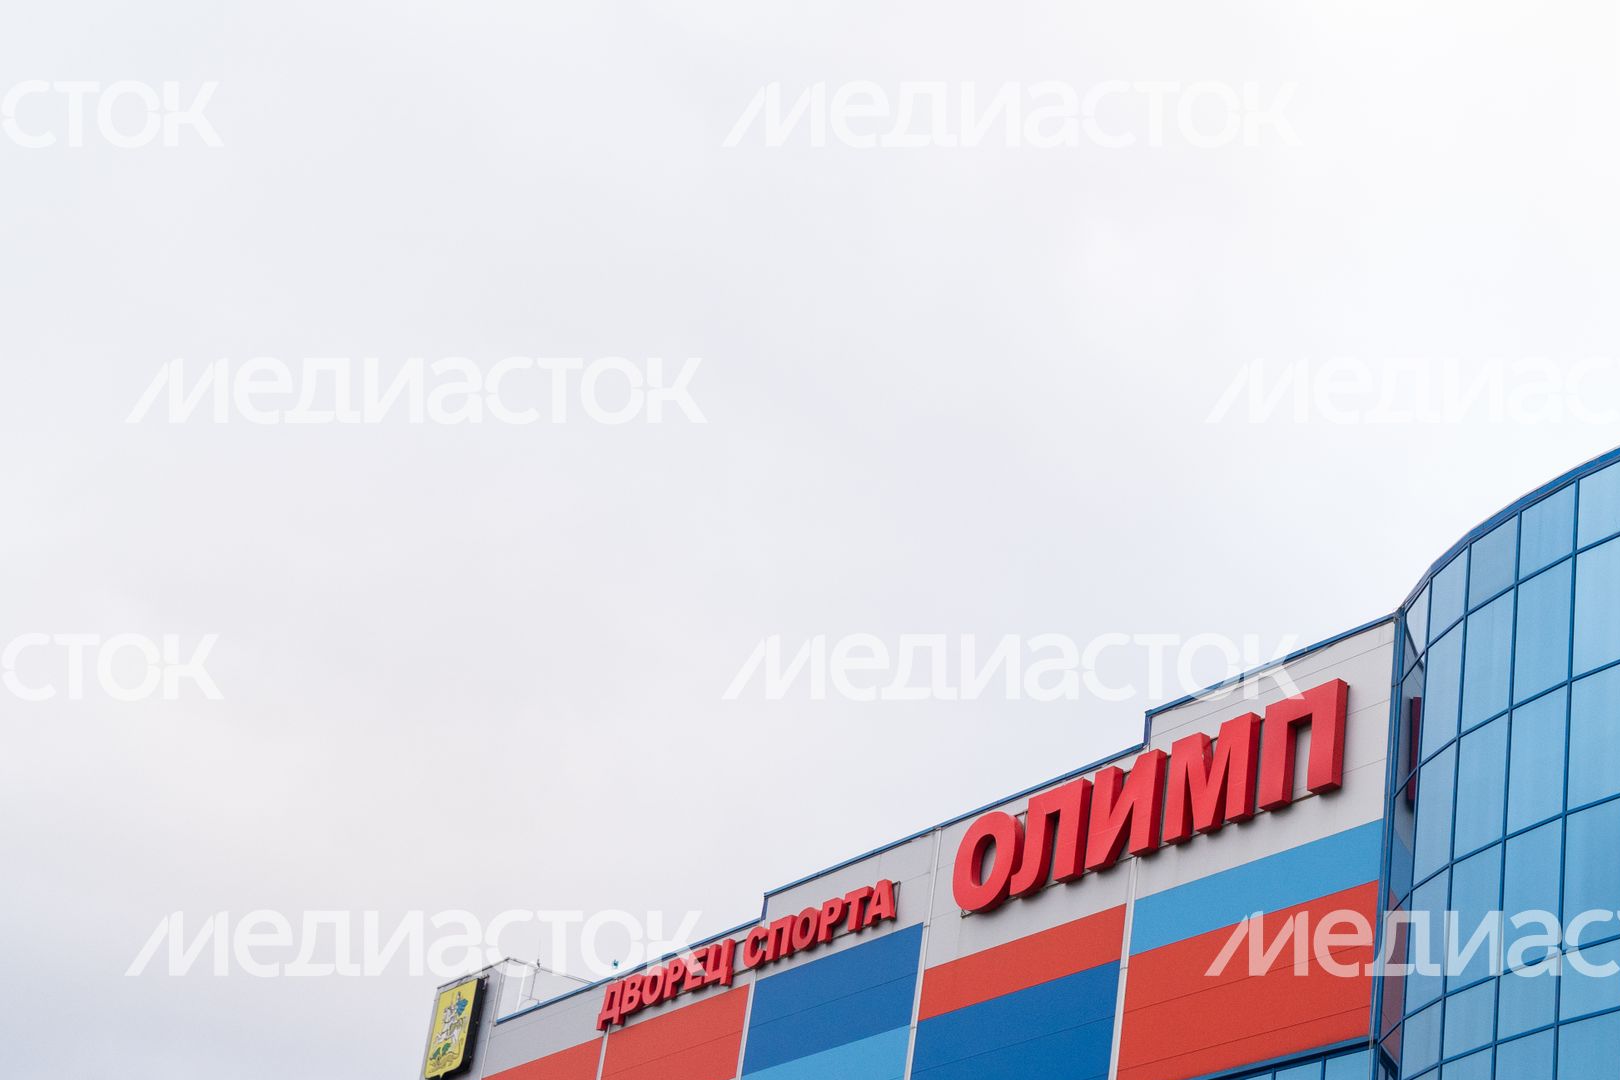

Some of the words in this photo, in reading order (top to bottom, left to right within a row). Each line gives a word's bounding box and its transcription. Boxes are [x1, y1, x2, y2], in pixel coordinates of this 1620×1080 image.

[952, 678, 1349, 914] ОЛИМП
[596, 938, 736, 1031] ДВОРЕЦ
[743, 879, 897, 969] СПОРТА
